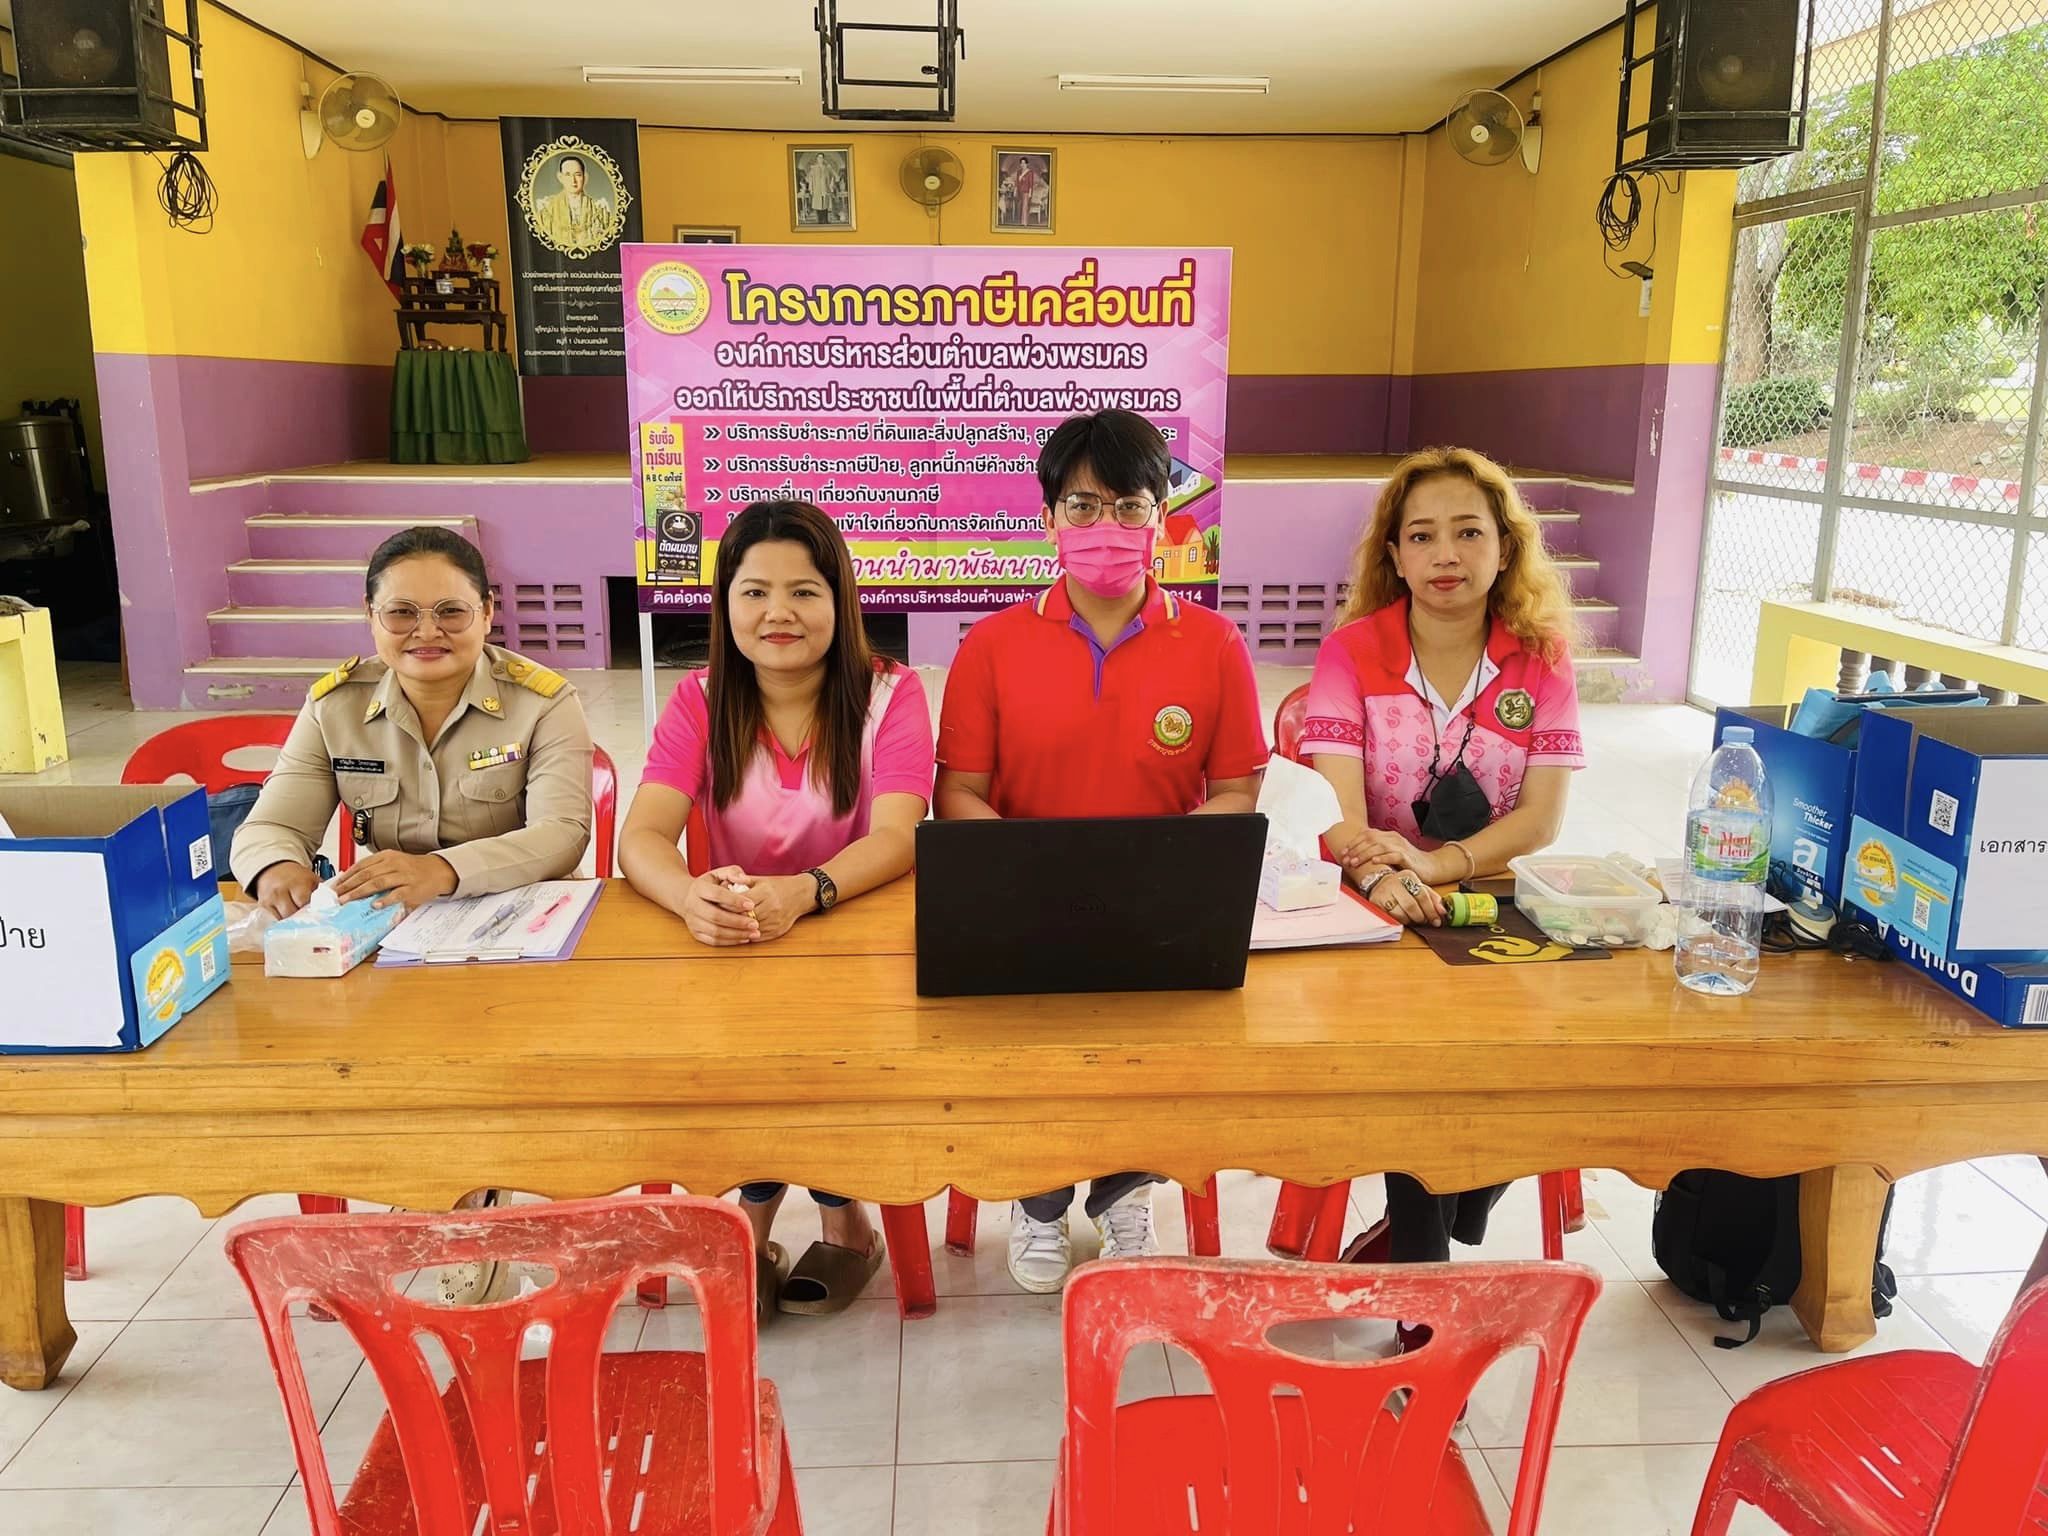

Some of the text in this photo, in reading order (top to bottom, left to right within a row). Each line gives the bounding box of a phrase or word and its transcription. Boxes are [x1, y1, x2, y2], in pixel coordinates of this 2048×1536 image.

[724, 260, 1195, 324] โครงการภาษีเคลื่อนที่
[716, 335, 1146, 366] องค์การบริหารส่วนตำบลพ่วงพรมคร
[675, 375, 1180, 410] ออกให้บริการประชาชนในพื้นที่ตำบลพ่วงพรมคร
[727, 423, 869, 441] บริการรับชำระภาษี
[727, 450, 1038, 478] บริการรับชำระภาษีป้าย, ลูกหนี้ภาษีค้างชำ
[818, 480, 940, 502] เกี่ยวกับงานภาษี
[653, 589, 713, 605] ติดต่อกอ
[860, 590, 1038, 605] องค์การบริหารส่วนตำบลพ่ว
[1793, 798, 1828, 818] Smoother
[1803, 811, 1834, 831] Thicker
[1980, 839, 2048, 854] เอกสาร
